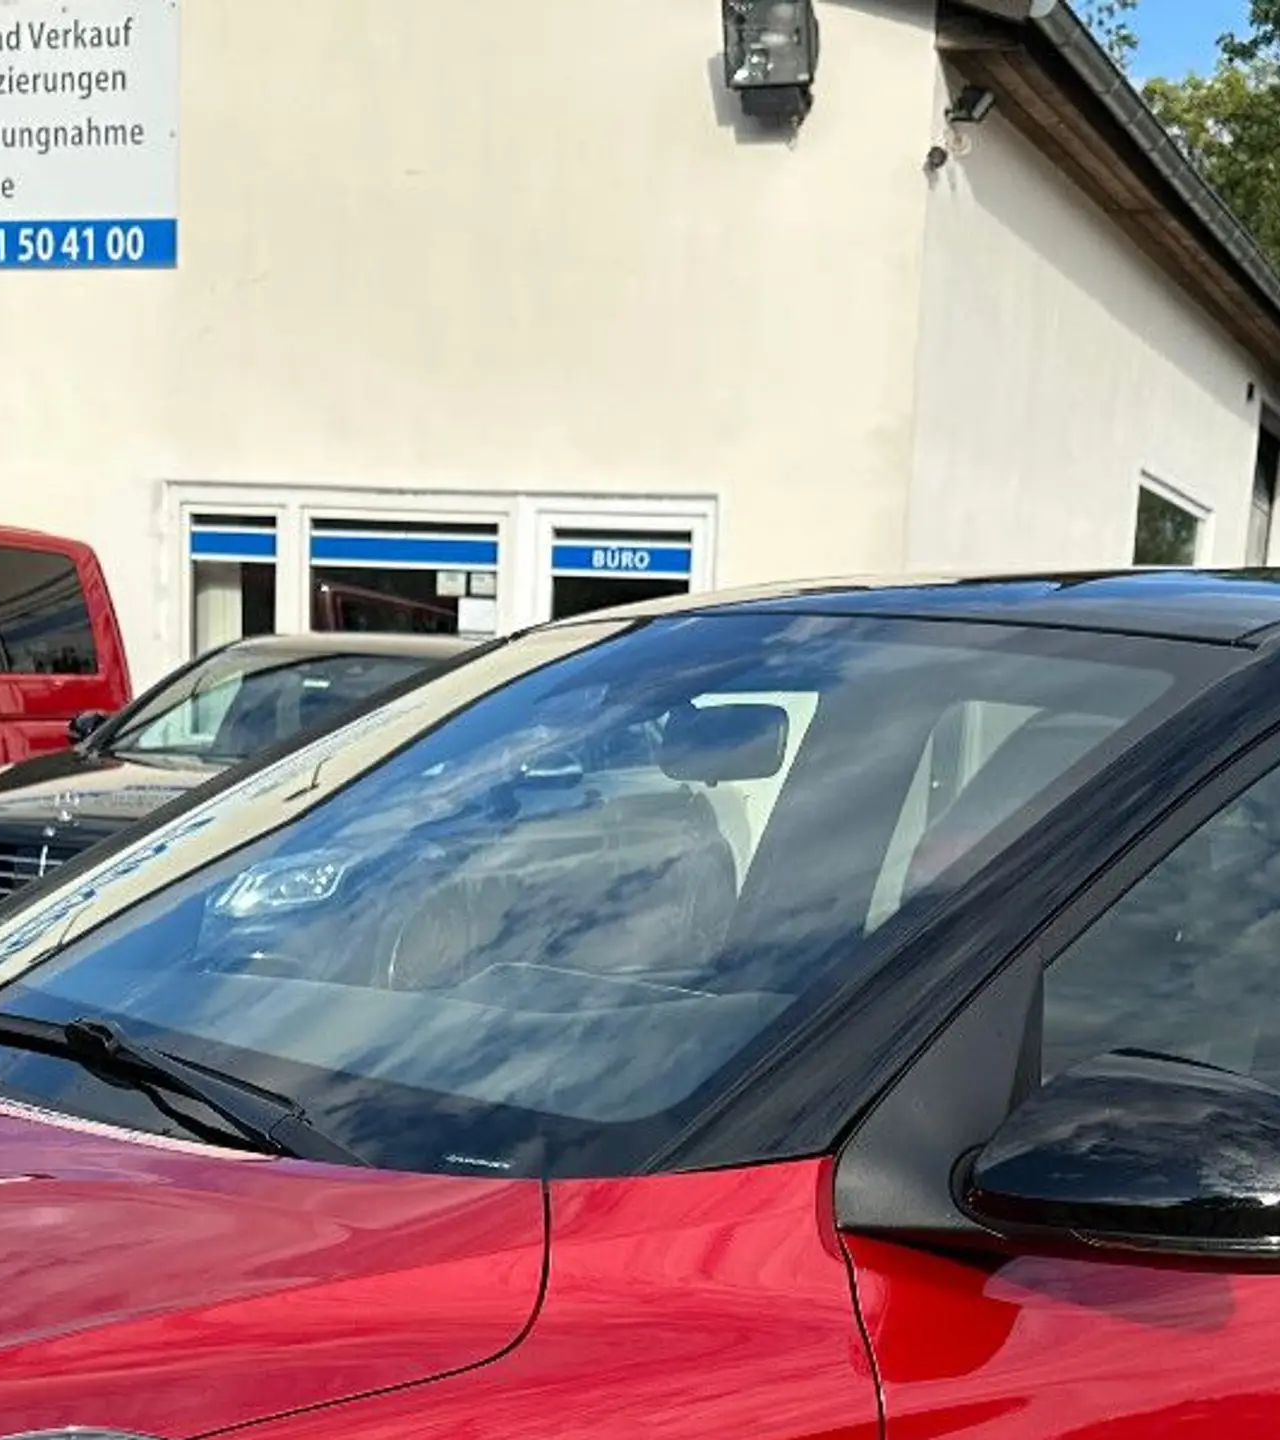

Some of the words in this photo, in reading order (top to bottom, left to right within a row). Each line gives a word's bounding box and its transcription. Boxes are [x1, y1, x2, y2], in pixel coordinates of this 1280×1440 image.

[27, 16, 133, 50] Verkauf
[17, 226, 55, 262] 50
[60, 226, 95, 261] 41
[105, 225, 145, 261] 00
[591, 546, 651, 569] BÜRO
